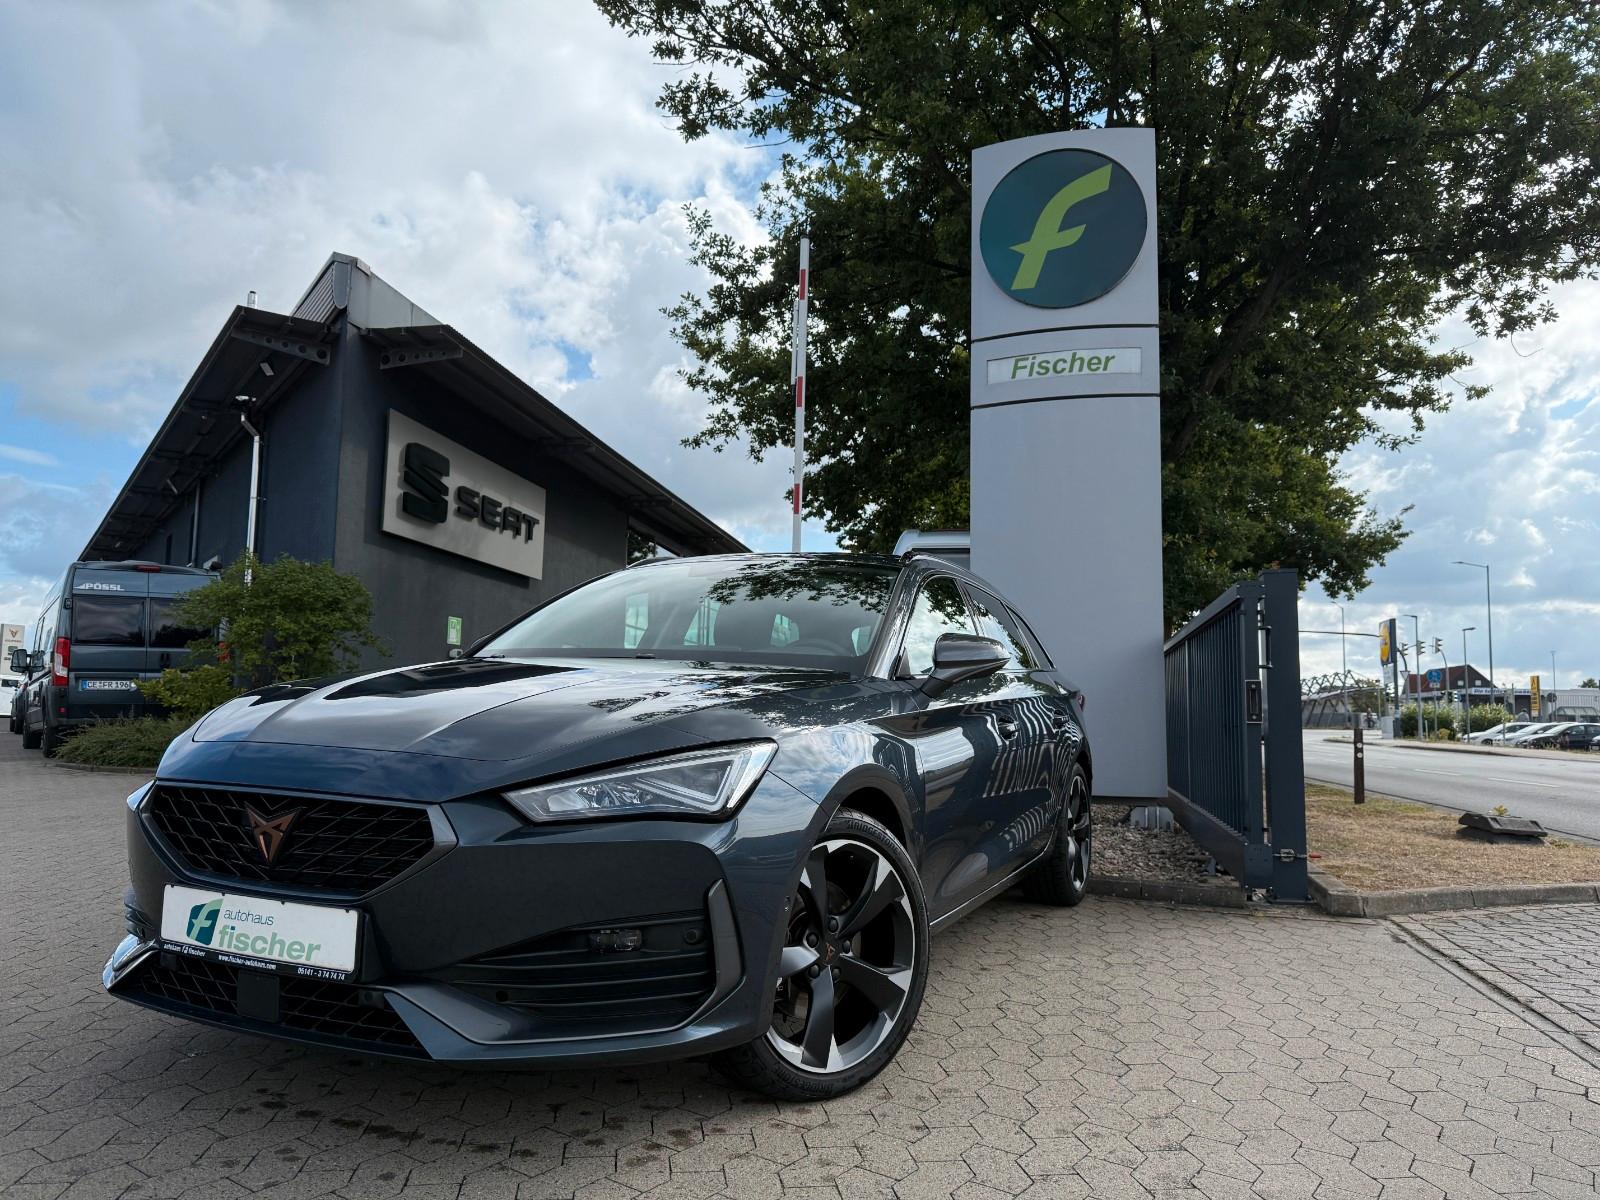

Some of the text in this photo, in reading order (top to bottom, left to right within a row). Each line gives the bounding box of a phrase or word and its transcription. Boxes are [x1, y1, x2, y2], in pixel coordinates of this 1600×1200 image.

[1010, 352, 1115, 379] Fischer
[456, 485, 540, 541] SEAT
[223, 908, 274, 926] autohaus
[218, 925, 321, 961] fischer
[297, 967, 313, 976] 05141
[338, 973, 345, 981] 74
